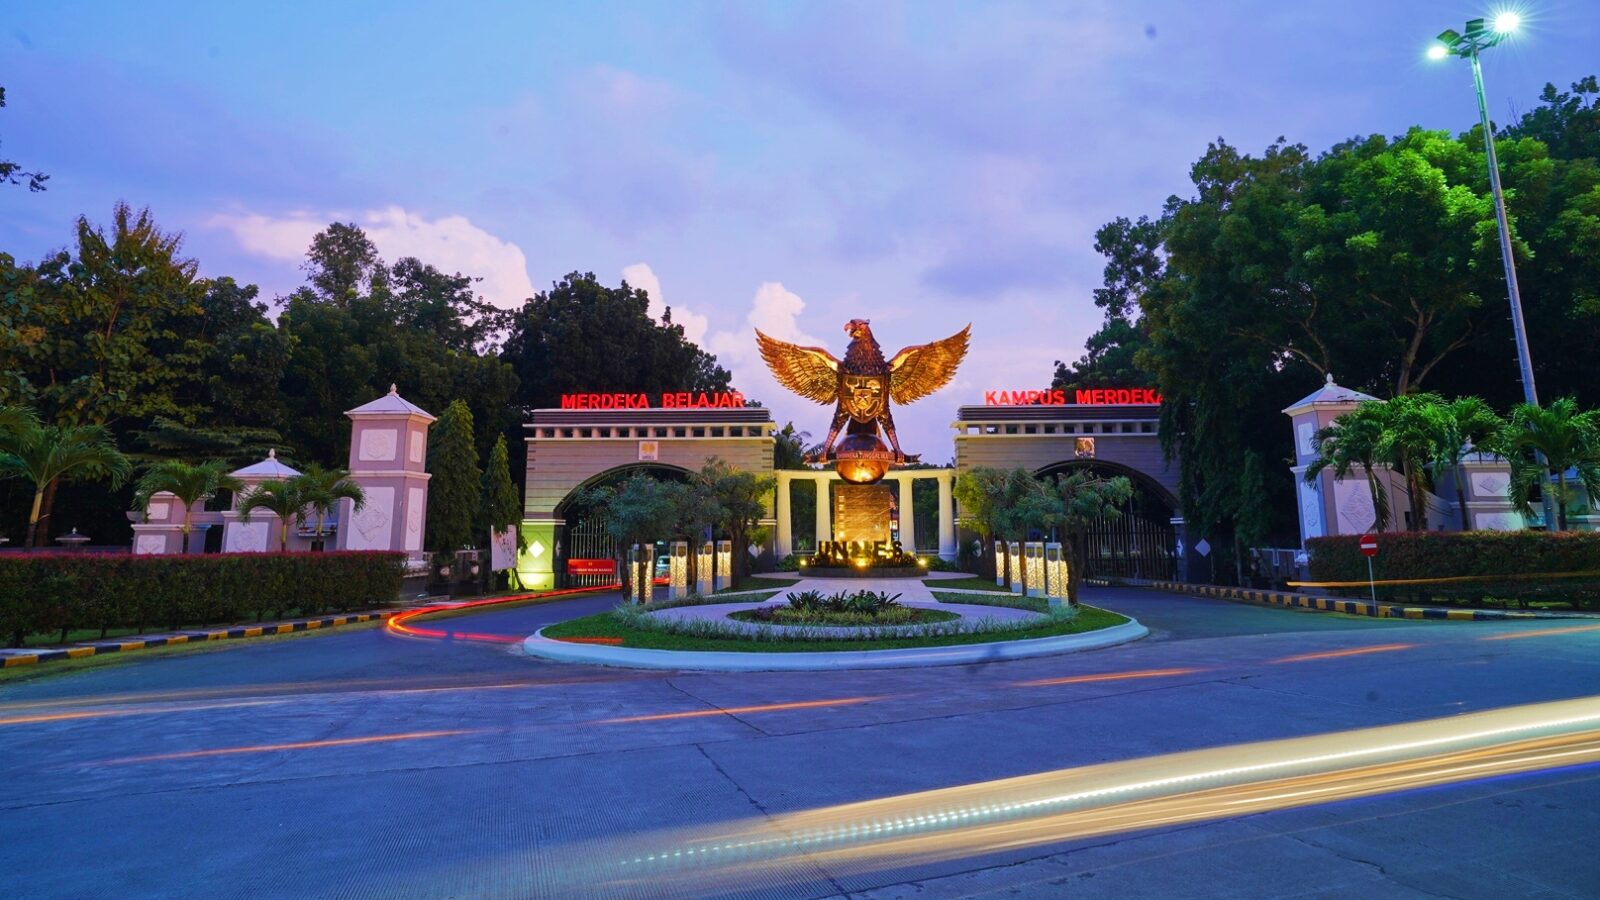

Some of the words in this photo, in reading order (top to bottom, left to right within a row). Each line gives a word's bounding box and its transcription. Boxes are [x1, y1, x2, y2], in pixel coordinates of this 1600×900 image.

[561, 393, 649, 409] MERDEKA
[662, 392, 745, 408] BELAJAR
[984, 390, 1065, 406] KAMPUS
[818, 540, 903, 560] UNNES
